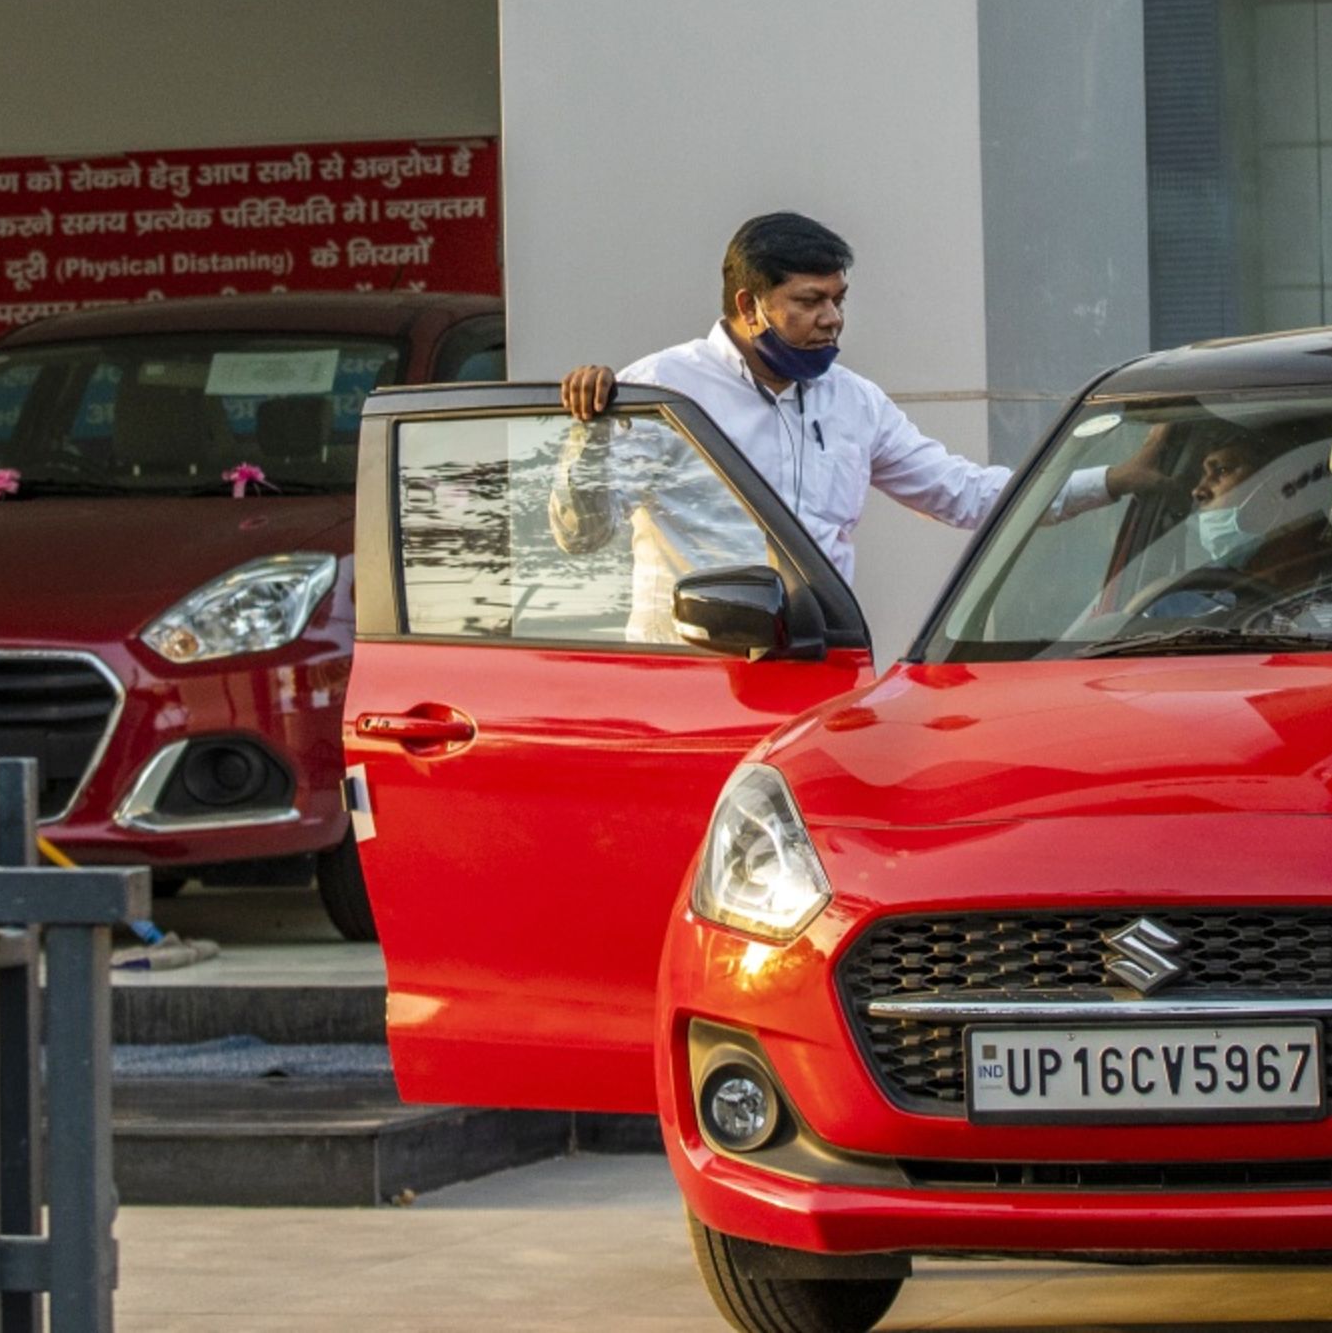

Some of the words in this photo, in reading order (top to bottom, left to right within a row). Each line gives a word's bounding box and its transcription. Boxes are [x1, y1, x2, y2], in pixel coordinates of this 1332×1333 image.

[27, 164, 63, 192] को
[69, 157, 141, 191] रोकने
[149, 159, 190, 197] हेतु
[197, 163, 250, 186] आप
[257, 151, 312, 183] सभी
[320, 152, 344, 181] से
[351, 149, 443, 189] अनुरोध
[61, 211, 126, 236] समय
[134, 202, 213, 236] प्रत्येक
[220, 194, 336, 228] परिस्थिति
[385, 196, 487, 231] न्यूनतम
[6, 250, 47, 291] दूरी
[55, 255, 165, 283] (Physical
[172, 250, 294, 275] Distaning)
[310, 240, 339, 268] के
[346, 236, 434, 267] नियमों
[978, 1064, 1004, 1079] IND
[1007, 1042, 1312, 1097] UP16CV5967
